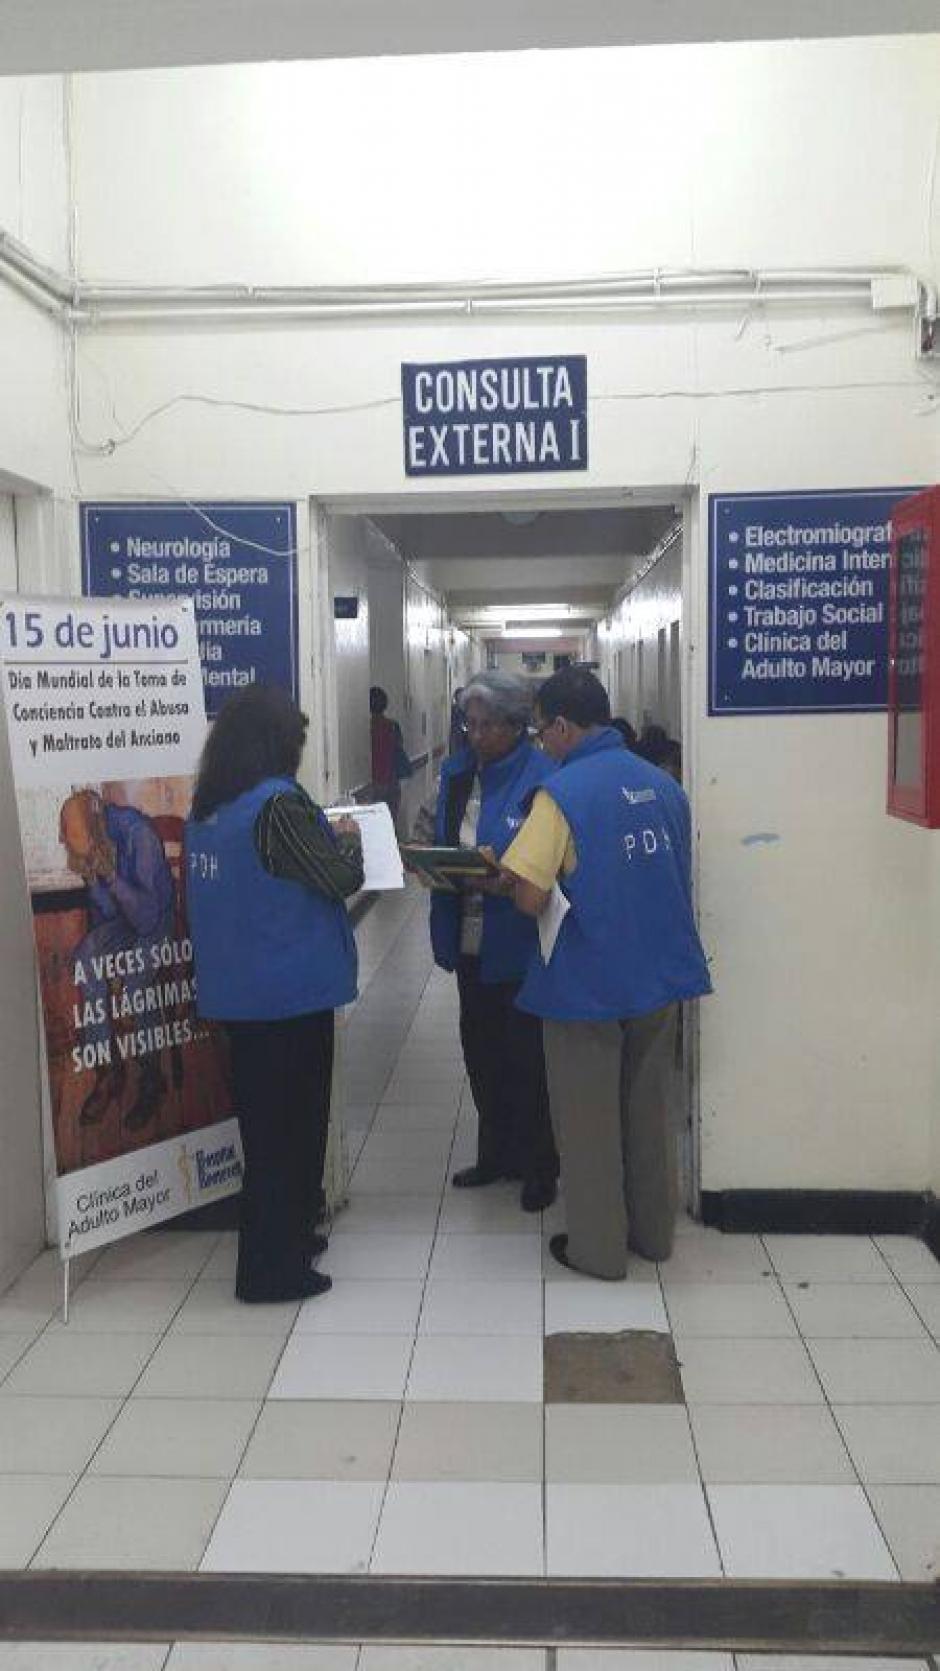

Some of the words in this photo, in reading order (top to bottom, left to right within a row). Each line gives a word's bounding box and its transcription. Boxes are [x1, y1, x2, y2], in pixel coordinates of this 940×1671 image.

[415, 365, 573, 413] CONSULTA
[409, 421, 561, 468] EXTERNA
[569, 419, 582, 461] I
[126, 537, 231, 562] Neurología
[745, 551, 837, 573] Medicina
[843, 550, 893, 570] Inter
[126, 563, 170, 584] Sala
[175, 563, 200, 584] de
[204, 564, 269, 587] Espera
[745, 575, 873, 600] Clasificación
[197, 615, 262, 636] rmería
[743, 605, 817, 629] Trabajo
[822, 602, 883, 625] Social
[5, 611, 44, 648] 15
[55, 614, 95, 648] de
[100, 615, 179, 659] junio
[816, 630, 847, 650] del
[37, 668, 94, 690] Mundial
[98, 669, 114, 688] de
[118, 669, 130, 688] la
[171, 669, 187, 686] de
[741, 659, 806, 680] Adulto
[812, 657, 876, 681] Mayor
[13, 701, 84, 722] Conciencia
[89, 701, 131, 719] Contra
[135, 700, 147, 717] el
[29, 738, 38, 758] y
[43, 732, 102, 752] Maltrato
[106, 730, 126, 748] del
[74, 960, 87, 985] A
[91, 947, 145, 981] VECES
[151, 936, 193, 968] SÓLO
[73, 999, 106, 1029] LAS
[72, 1039, 112, 1073] SON
[116, 1018, 210, 1060] VISIBLES...
[135, 1169, 159, 1192] del
[69, 1207, 120, 1238] Adulto
[123, 1188, 171, 1217] Mayor
